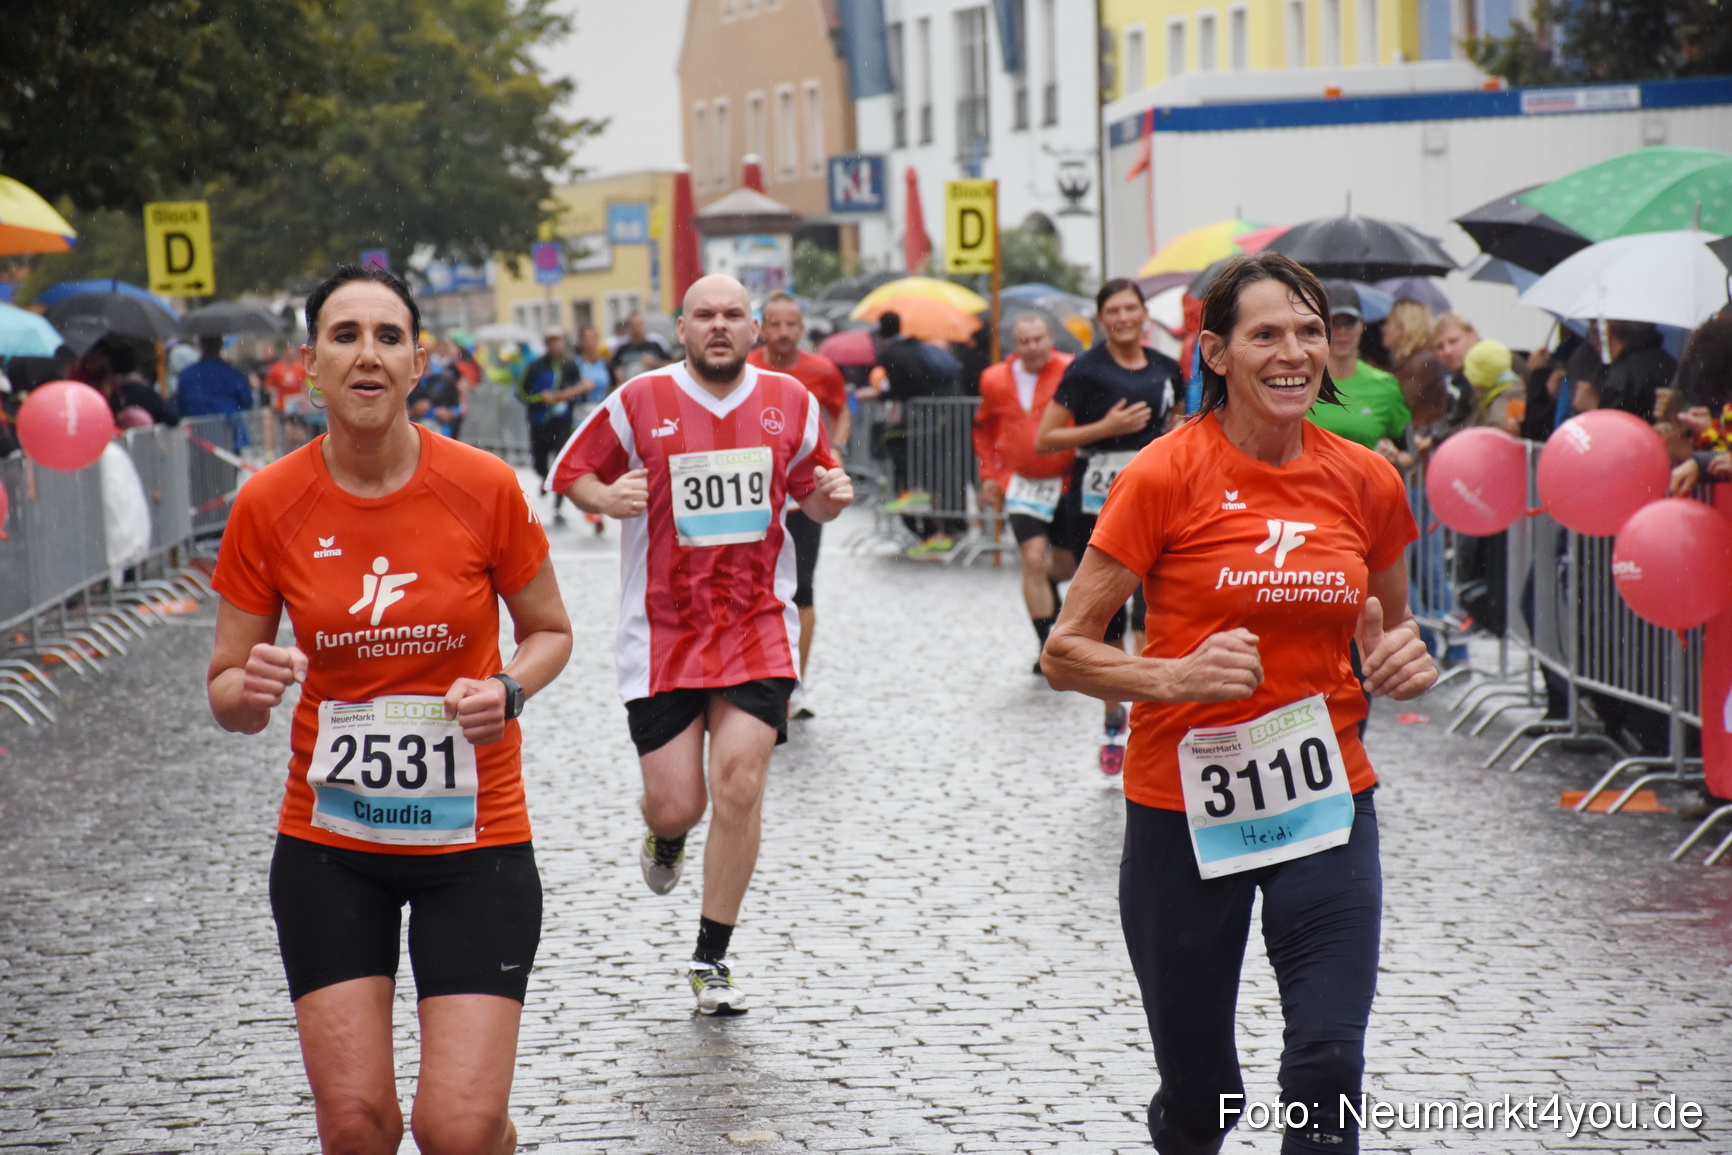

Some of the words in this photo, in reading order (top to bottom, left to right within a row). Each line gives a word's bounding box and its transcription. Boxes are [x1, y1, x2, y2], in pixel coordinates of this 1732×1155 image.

[152, 208, 199, 225] Block
[960, 209, 985, 249] D
[165, 232, 195, 274] D
[715, 452, 763, 465] BOCK
[684, 472, 764, 511] 3019
[314, 548, 342, 558] erima
[1215, 567, 1345, 590] funrunners
[1256, 585, 1360, 604] neumarkt
[316, 623, 449, 651] funrunners
[357, 633, 466, 659] neumarkt
[331, 713, 375, 724] NeuerMarkt
[385, 701, 447, 720] BOC
[1249, 704, 1315, 744] BOCK
[1192, 743, 1242, 755] NeuerMarkt
[326, 734, 456, 790] 2531
[1201, 737, 1333, 818] 3110
[354, 800, 432, 825] Claudia
[1241, 826, 1293, 847] Heidi
